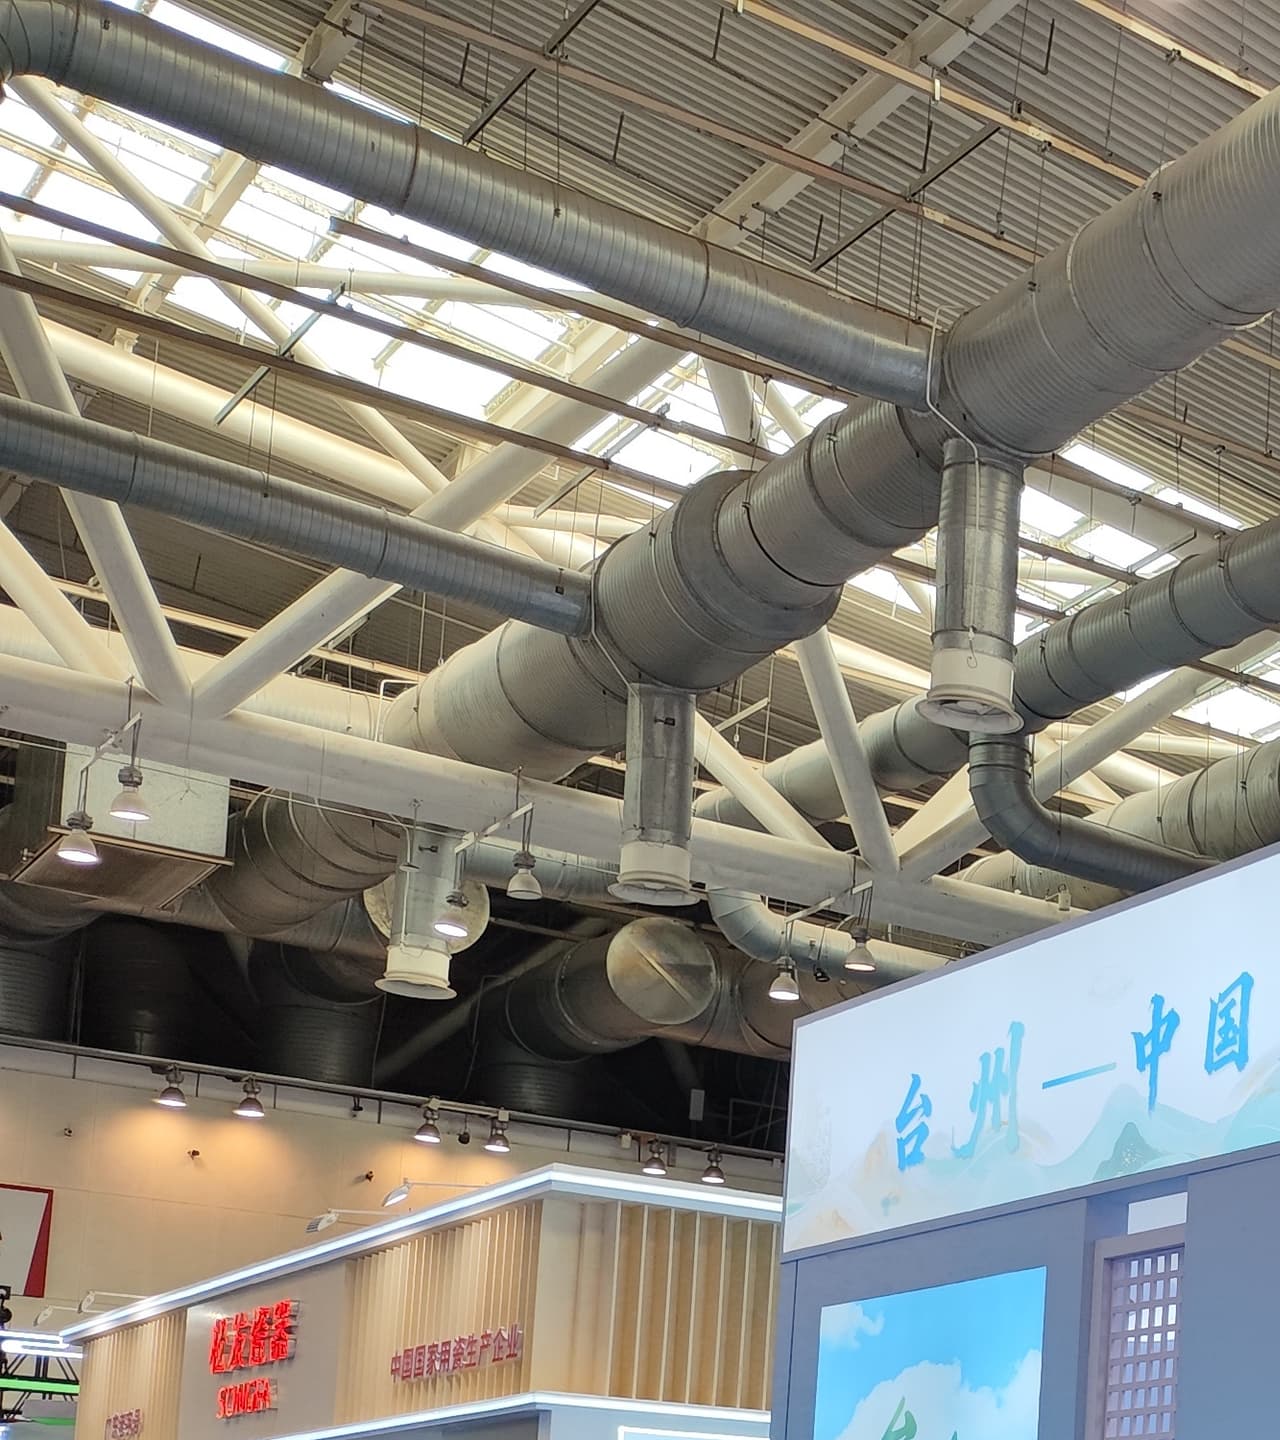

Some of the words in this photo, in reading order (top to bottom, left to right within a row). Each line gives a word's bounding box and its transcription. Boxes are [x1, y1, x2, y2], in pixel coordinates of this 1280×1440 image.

[391, 1323, 521, 1383] 中国国家用瓷生产企业
